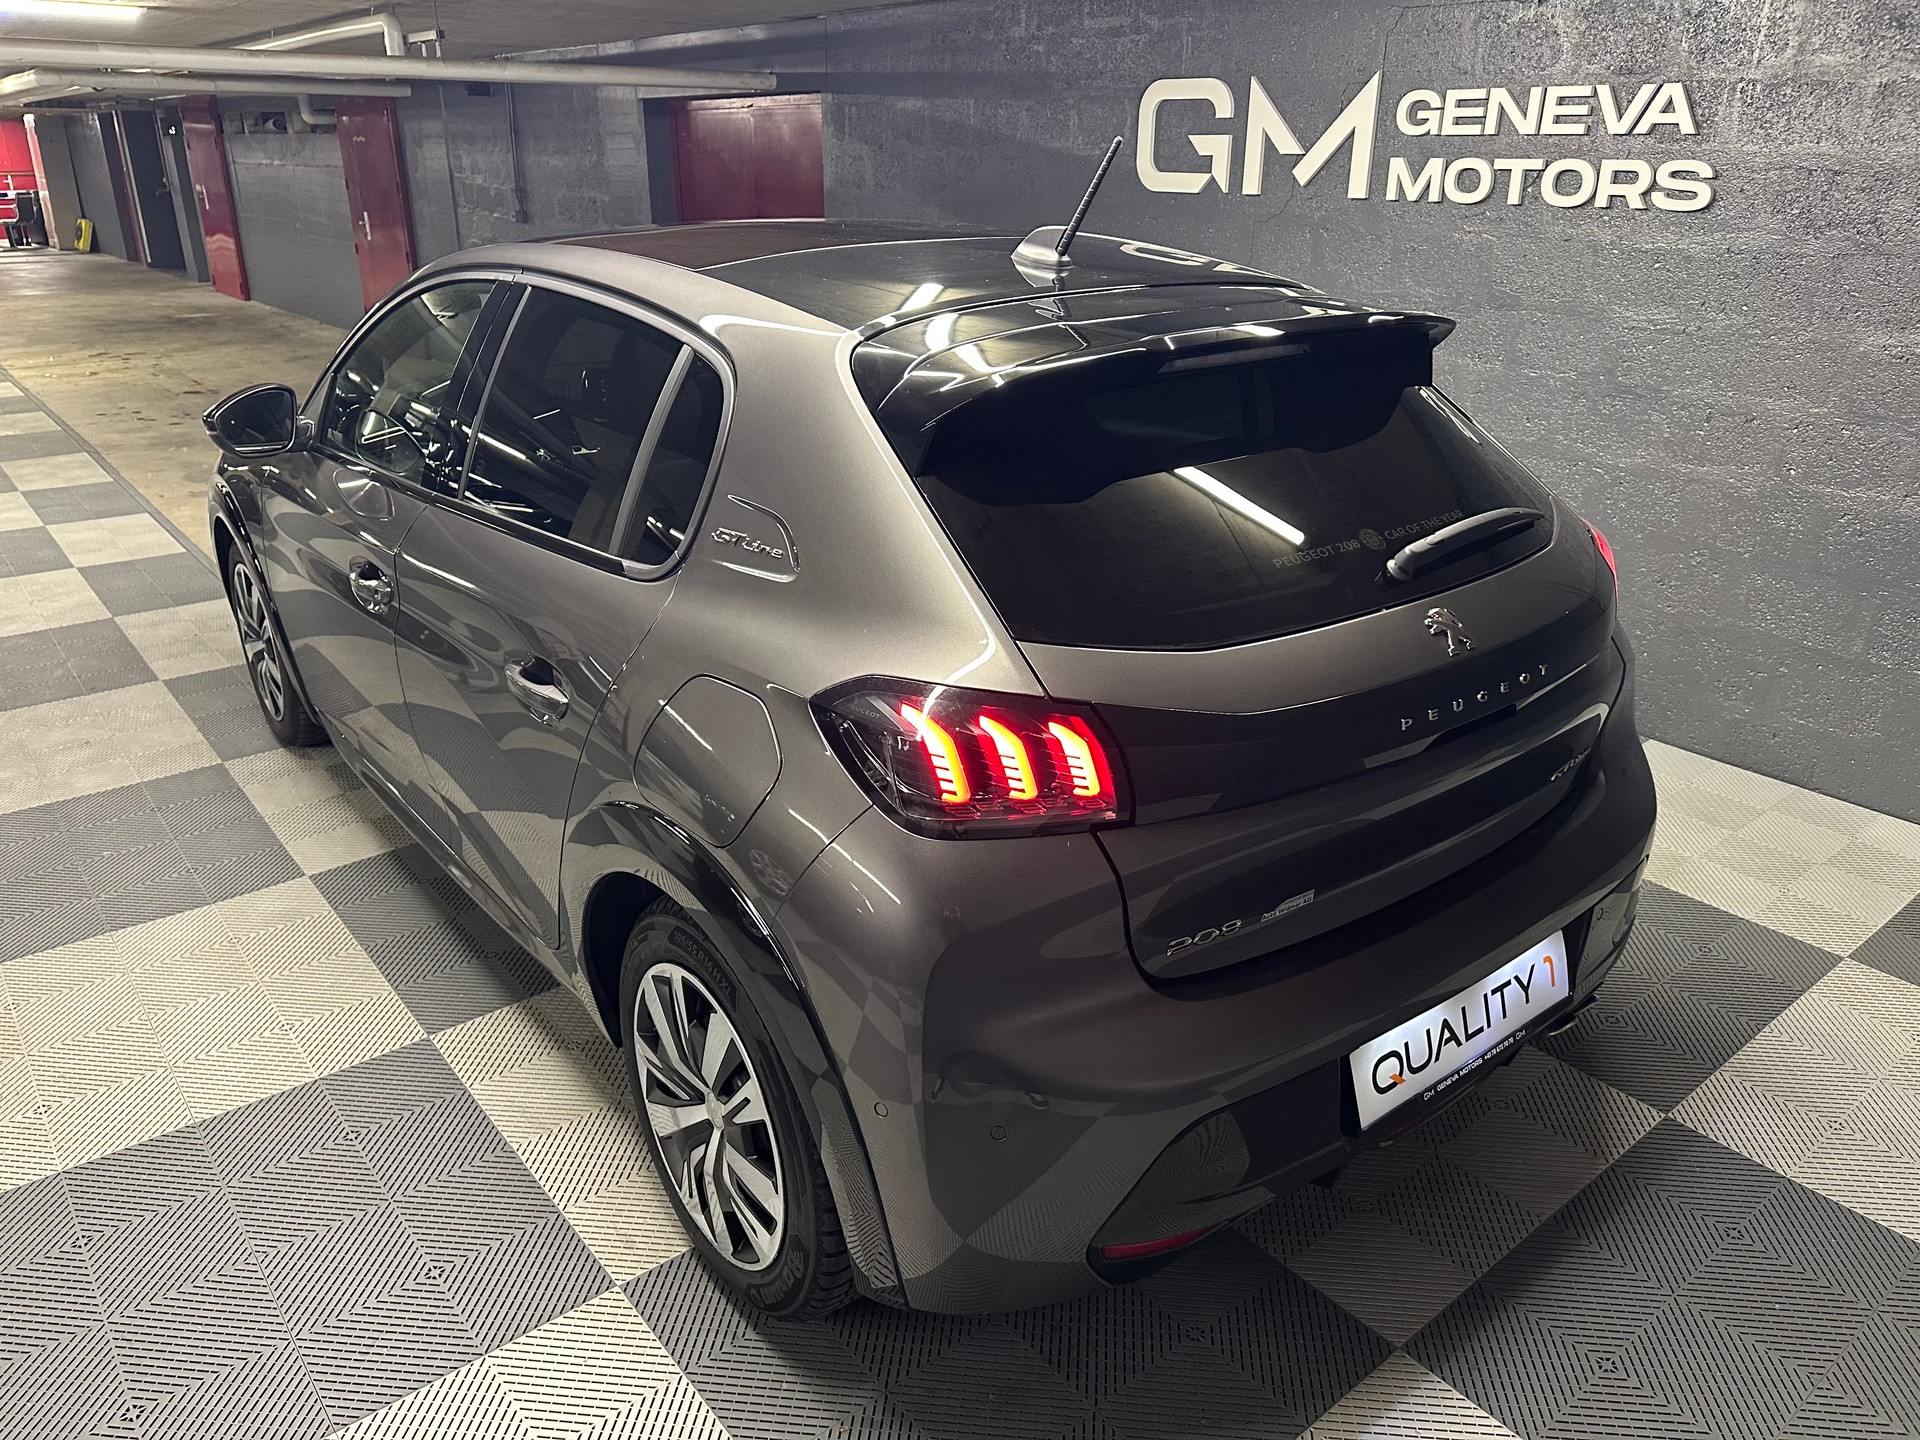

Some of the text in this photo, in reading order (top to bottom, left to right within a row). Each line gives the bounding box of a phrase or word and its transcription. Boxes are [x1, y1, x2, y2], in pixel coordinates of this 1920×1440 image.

[1136, 70, 1382, 199] GM
[1395, 83, 1699, 136] GENEVA
[1385, 157, 1718, 212] MOTORS
[1272, 509, 1465, 569] PEUGEOT 208 CAR OF THE YEAR
[1400, 663, 1549, 731] PEUGEOT
[1302, 896, 1312, 904] AG
[1166, 919, 1243, 957] 208
[1371, 954, 1556, 1095] QUALITY 1
[1423, 1089, 1435, 1101] GM
[1436, 1073, 1459, 1091] GENEVA
[1459, 1057, 1483, 1076] MOTORS
[1515, 1029, 1526, 1040] GM
